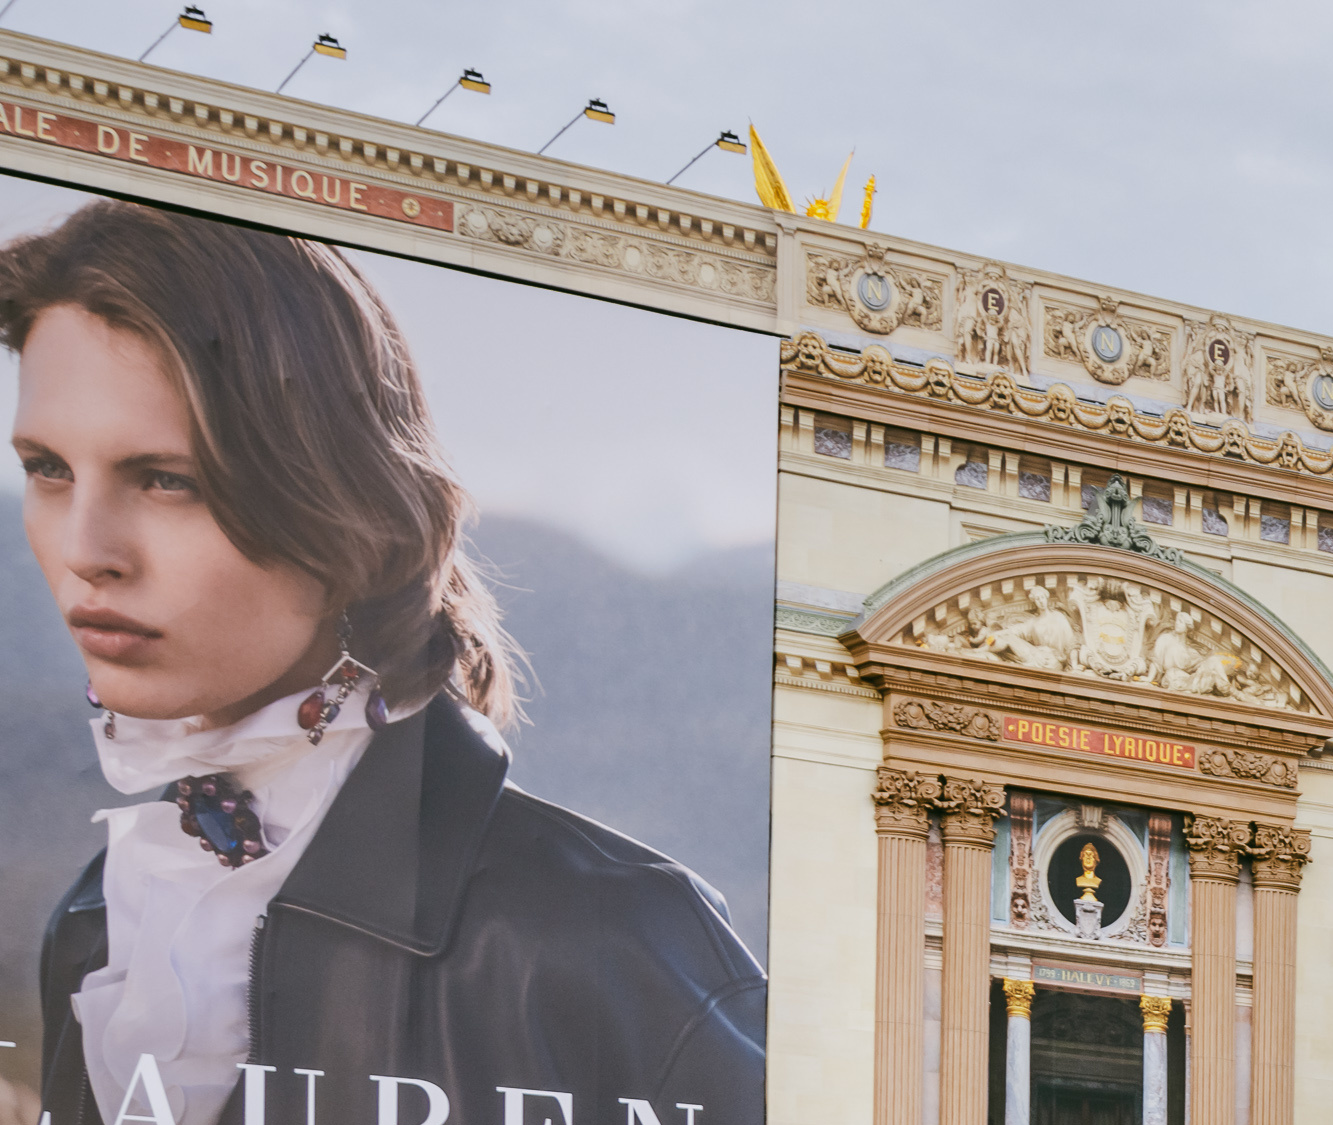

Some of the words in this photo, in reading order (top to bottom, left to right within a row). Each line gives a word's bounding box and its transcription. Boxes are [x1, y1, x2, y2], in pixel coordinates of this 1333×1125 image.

[97, 125, 150, 164] DE
[187, 144, 368, 212] MUSIQUE
[866, 279, 883, 302] N
[987, 292, 999, 312] E
[1102, 333, 1115, 356] N
[1213, 342, 1225, 361] E
[1018, 720, 1091, 750] POESIE
[1104, 734, 1183, 765] LYRIQUE
